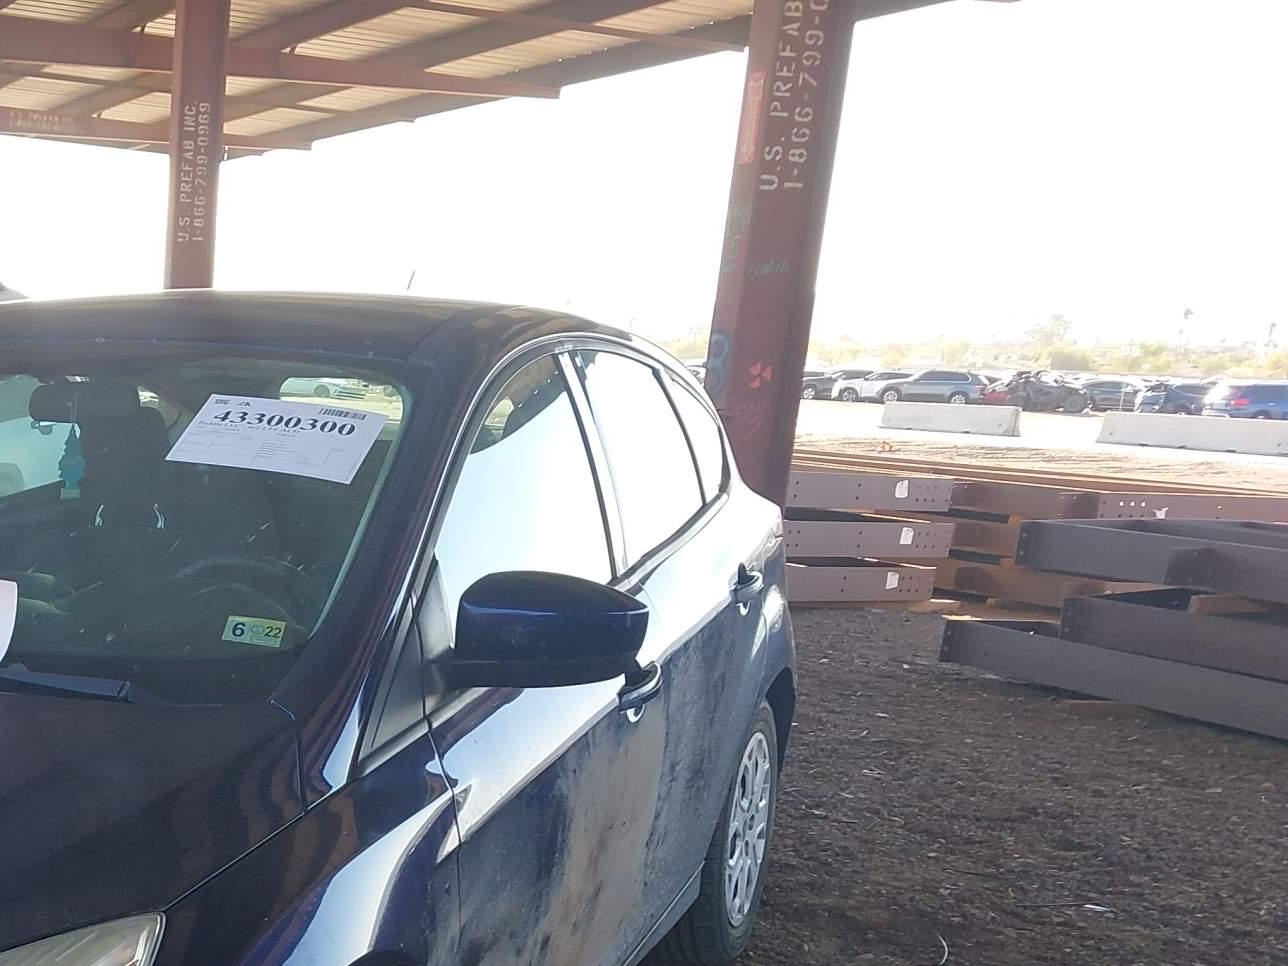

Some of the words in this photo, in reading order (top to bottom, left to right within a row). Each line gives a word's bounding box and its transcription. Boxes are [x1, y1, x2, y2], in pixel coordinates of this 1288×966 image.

[769, 0, 804, 118] PREFAB
[179, 140, 195, 202] PREFAB
[192, 102, 211, 241] 1-866-799-0969
[760, 136, 786, 191] U.S.
[213, 410, 356, 436] 43300300
[231, 622, 247, 637] 6
